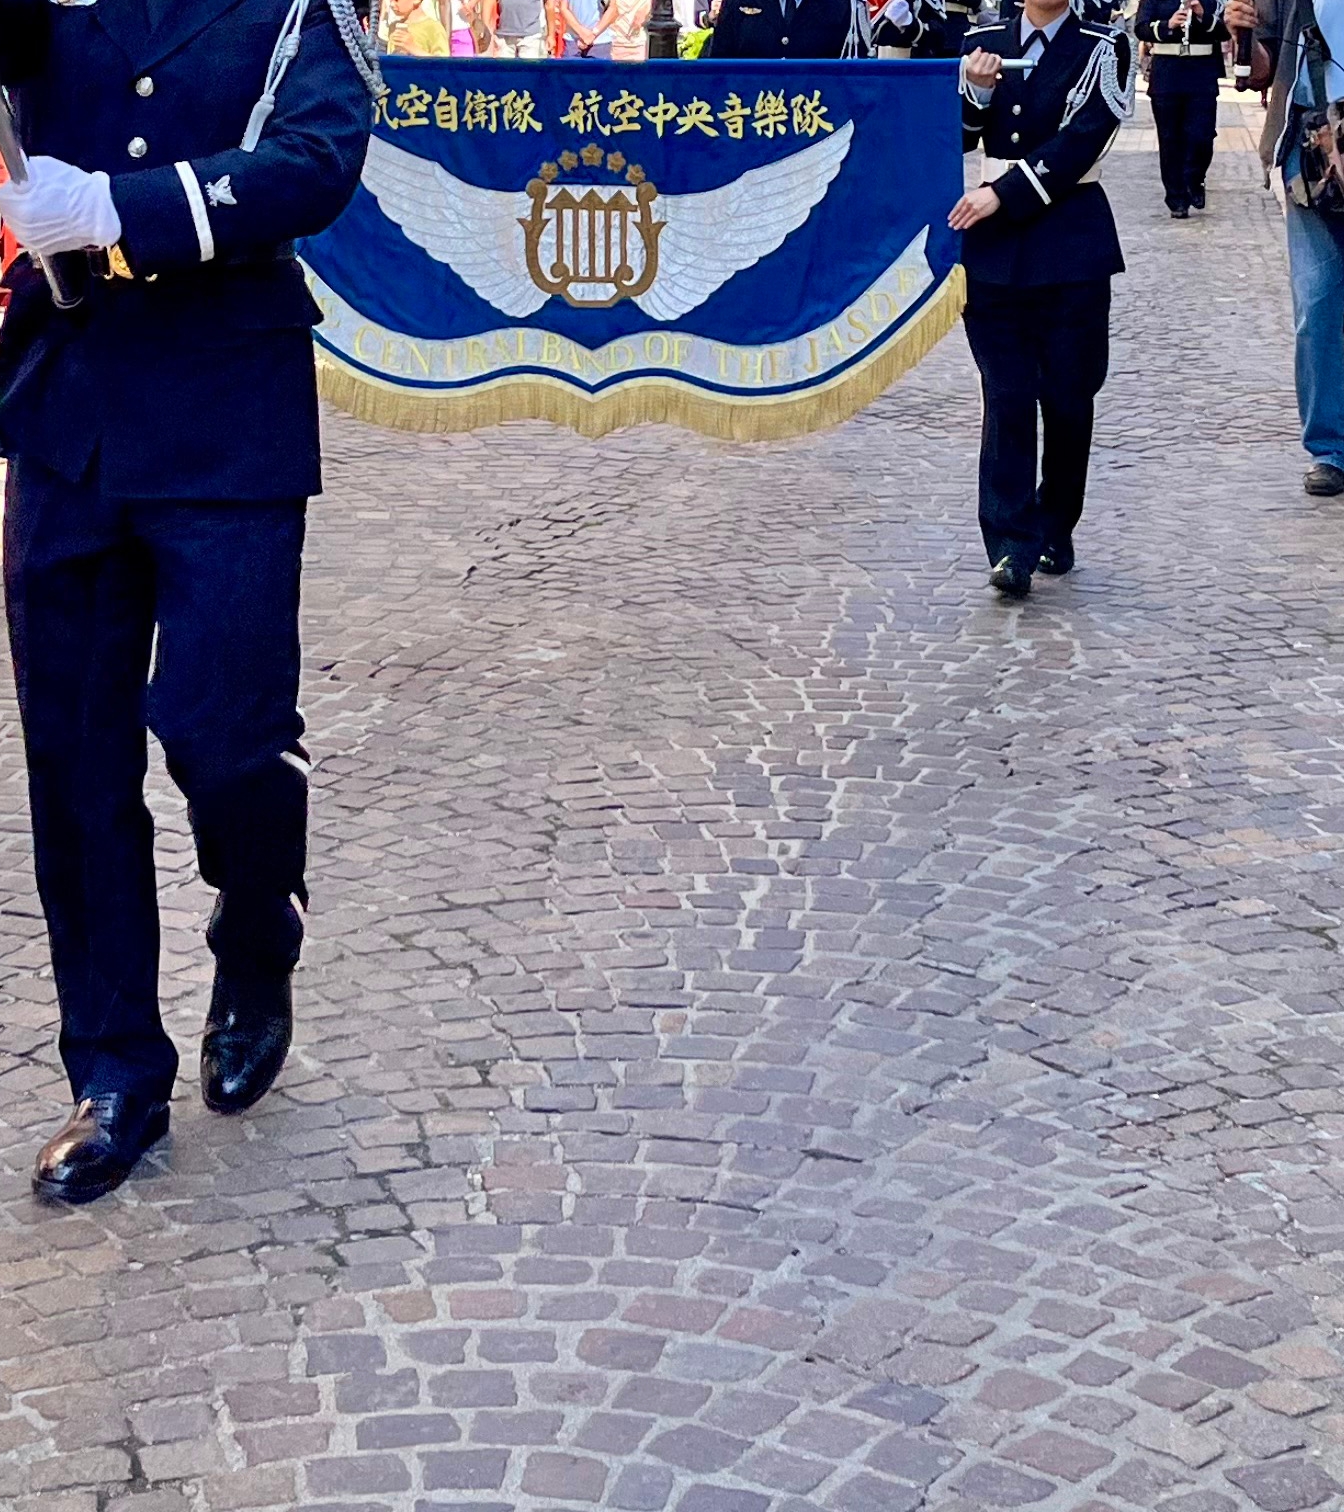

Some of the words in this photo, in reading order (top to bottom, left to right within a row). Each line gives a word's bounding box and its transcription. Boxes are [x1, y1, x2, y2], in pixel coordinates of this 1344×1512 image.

[355, 324, 539, 377] CENTRAL
[541, 332, 635, 378] BAND
[644, 332, 694, 368] OF
[709, 343, 794, 384] THE
[803, 265, 919, 374] JASDF
